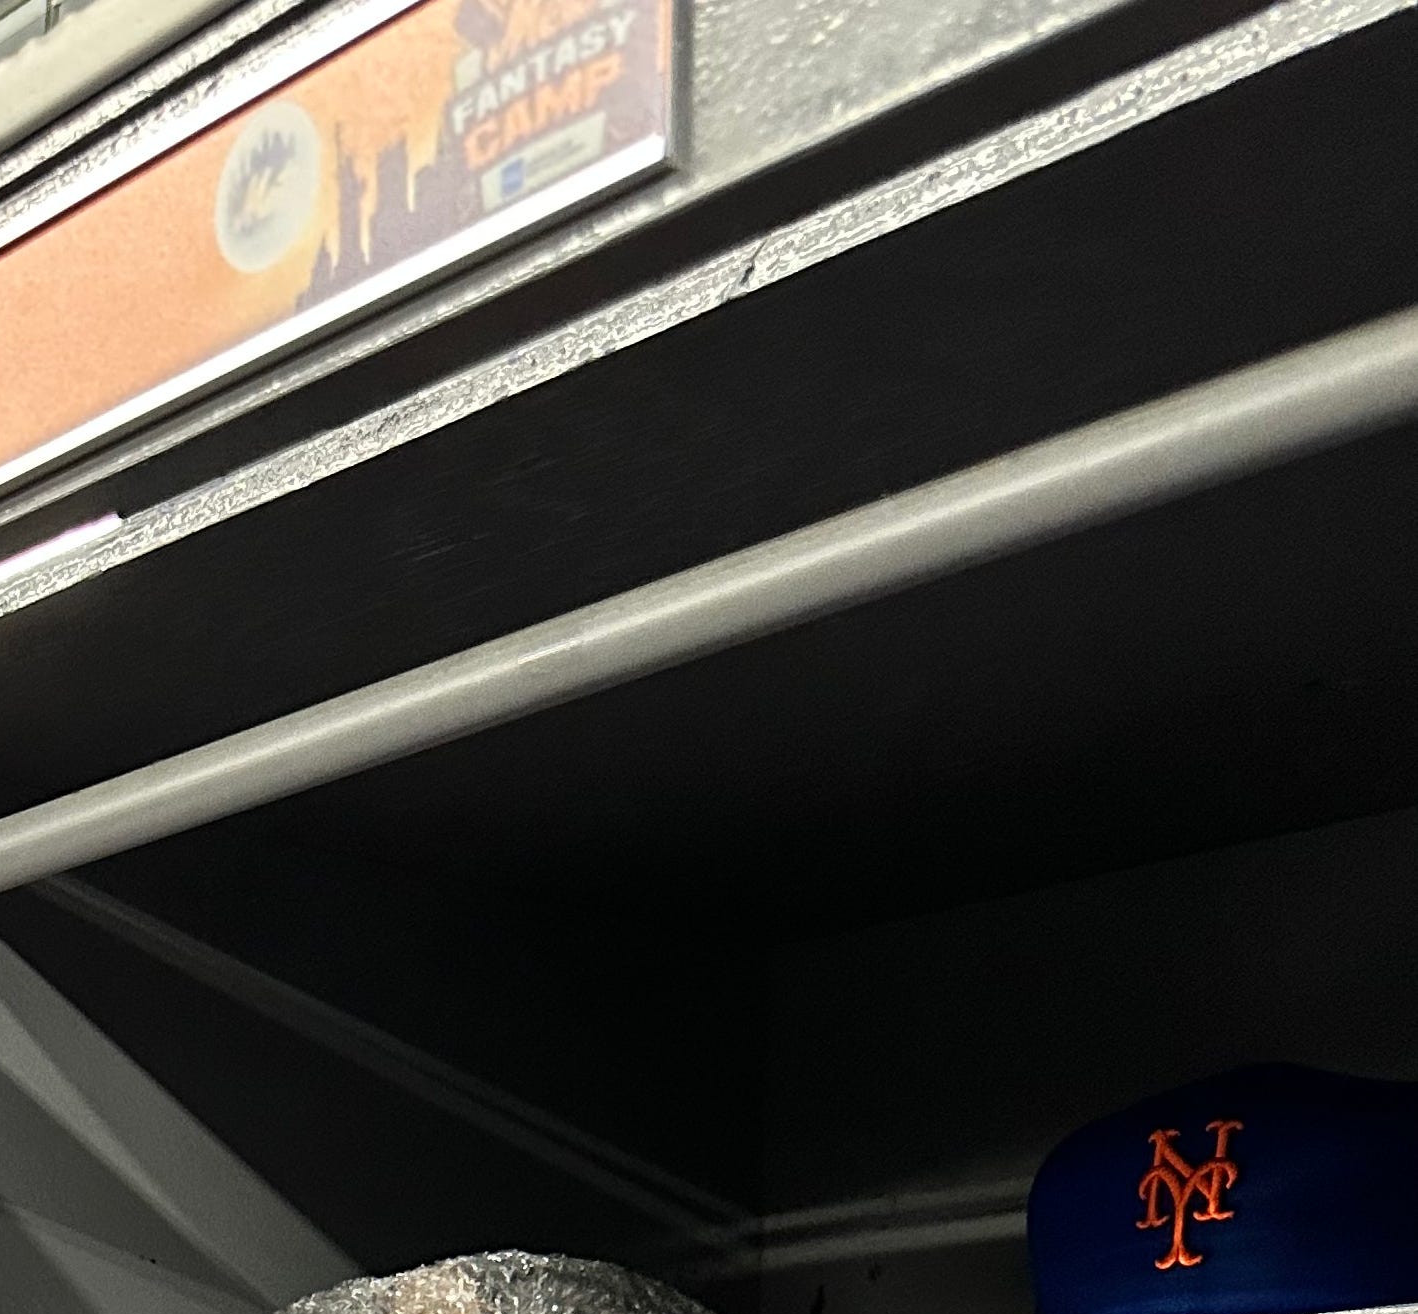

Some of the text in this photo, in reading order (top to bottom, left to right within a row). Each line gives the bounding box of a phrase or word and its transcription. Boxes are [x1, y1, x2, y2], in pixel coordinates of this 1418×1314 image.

[451, 8, 638, 135] FANTASY
[463, 52, 625, 170] CAMP
[1135, 1119, 1244, 1270] NY
